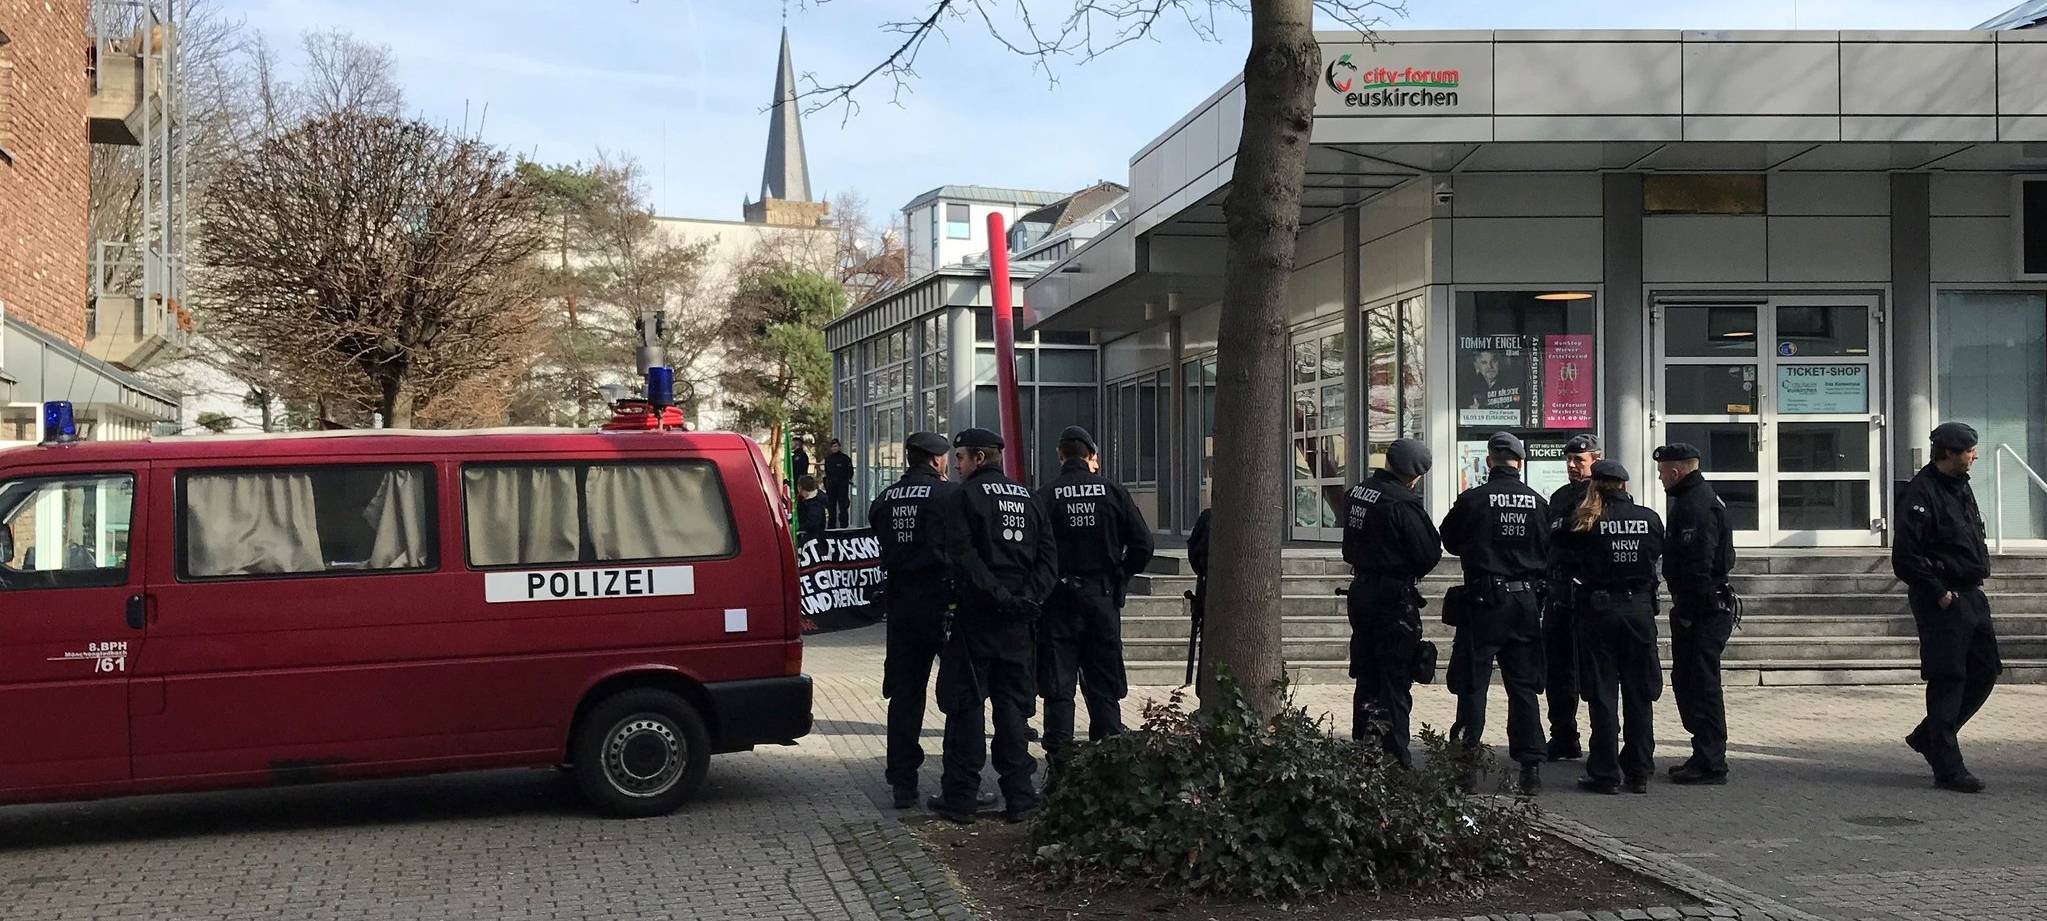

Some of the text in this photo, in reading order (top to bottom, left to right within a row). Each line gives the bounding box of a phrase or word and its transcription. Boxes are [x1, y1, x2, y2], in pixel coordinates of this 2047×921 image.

[1364, 67, 1459, 84] city-forum
[1345, 88, 1458, 107] euskirchen
[1460, 336, 1522, 349] TOMMY ENGEL
[1531, 337, 1539, 407] Karnevalsparty
[1787, 367, 1861, 377] TICKET-SHOP
[884, 485, 931, 501] POLIZEI
[982, 483, 1031, 498] POLIZEI
[1055, 484, 1106, 499] POLIZEI
[1350, 486, 1381, 504] POLIZEI
[999, 500, 1025, 514] NRW
[1067, 503, 1096, 514] NRW
[1489, 494, 1536, 509] POLIZEI
[892, 505, 918, 517] NRW
[1500, 512, 1527, 523] NRW
[892, 518, 915, 530] 3813
[1002, 514, 1025, 528] 3813
[1070, 515, 1096, 527] 3813
[1600, 520, 1649, 534] POLIZEI
[897, 531, 913, 543] RH
[1502, 525, 1525, 536] 3813
[1612, 540, 1640, 550] NRW
[1613, 552, 1638, 562] 3813
[528, 569, 653, 598] POLIZEI
[89, 641, 127, 652] 8.BPH
[94, 657, 125, 673] /61
